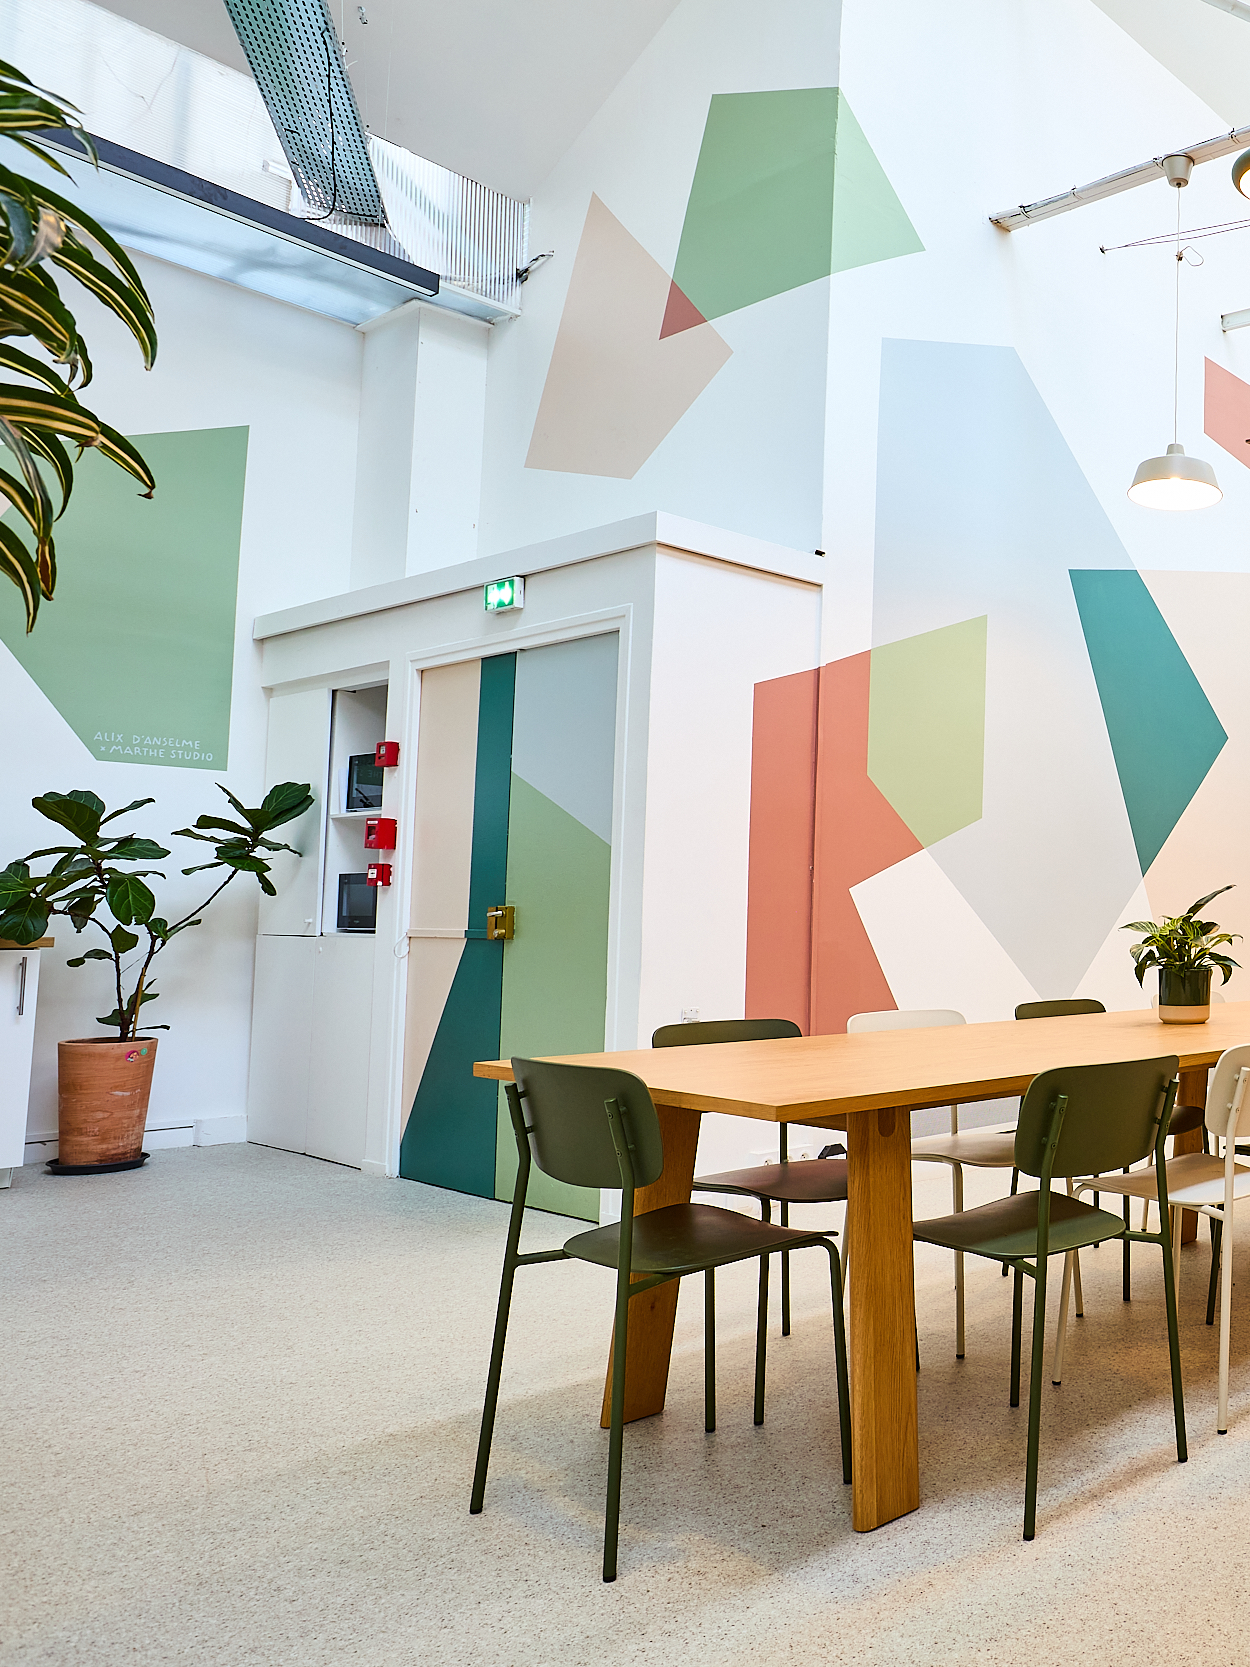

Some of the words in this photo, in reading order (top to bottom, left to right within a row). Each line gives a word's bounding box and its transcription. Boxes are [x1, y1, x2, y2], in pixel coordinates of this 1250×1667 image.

[93, 731, 124, 743] ALIX
[132, 734, 200, 750] D'ANSELME
[109, 745, 165, 758] MARTHE
[169, 749, 214, 761] STUDIO
